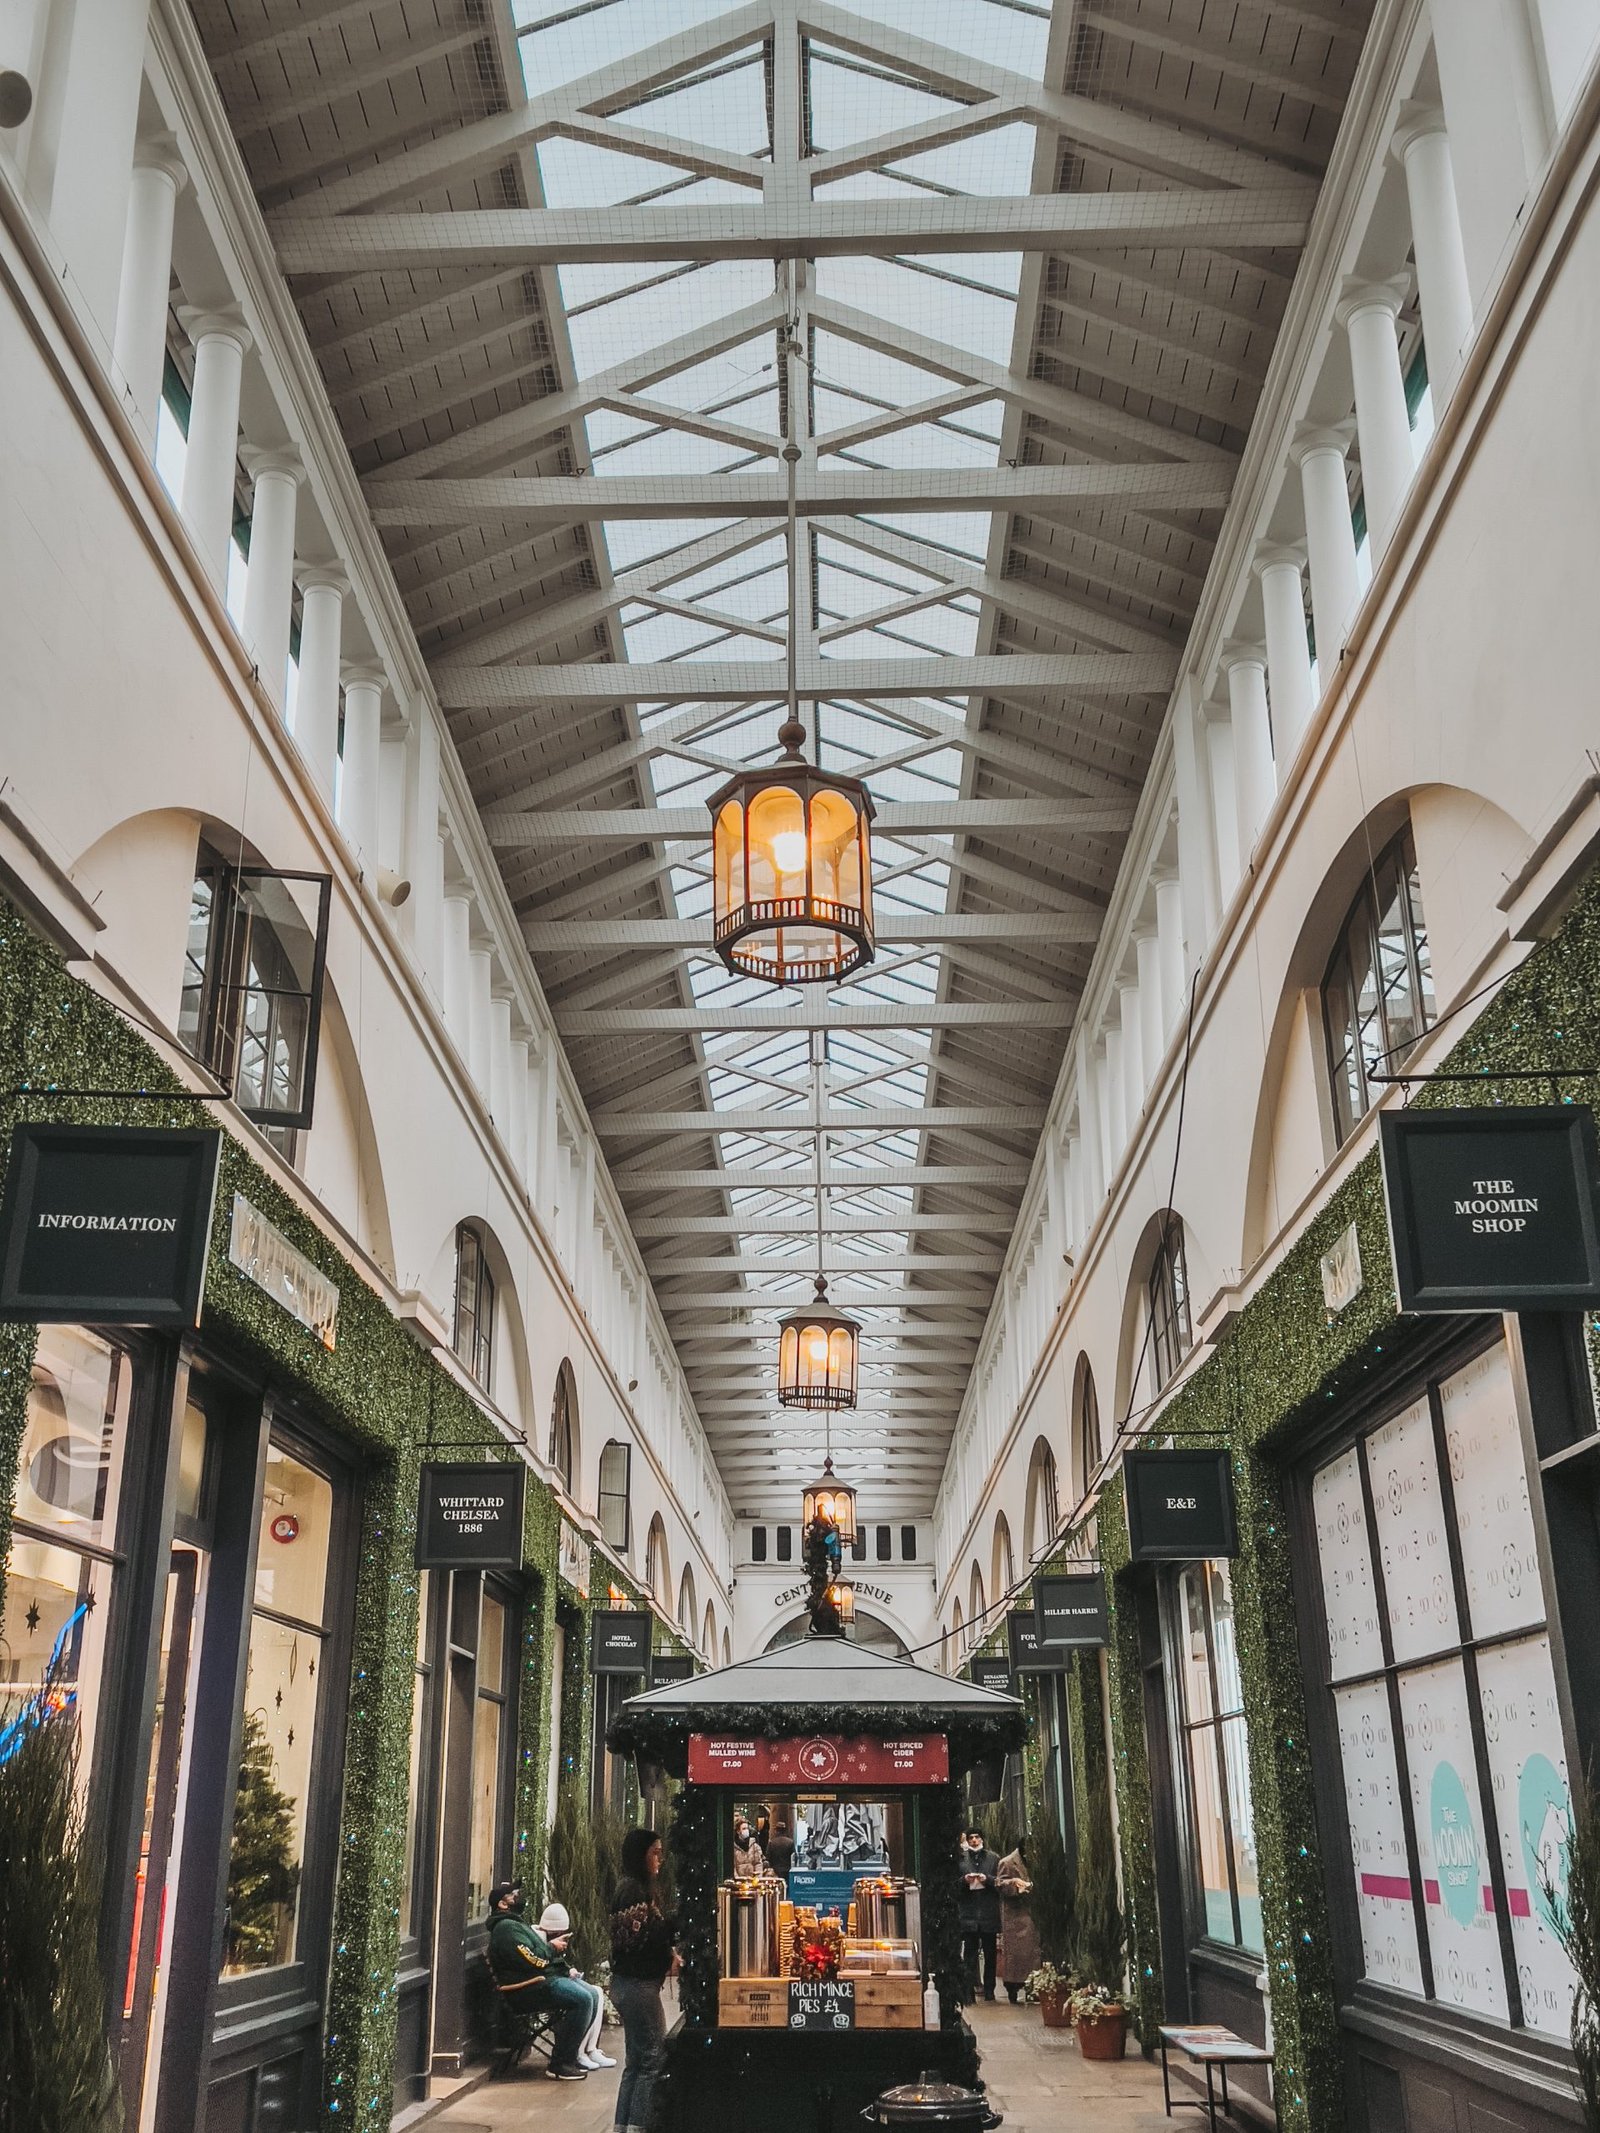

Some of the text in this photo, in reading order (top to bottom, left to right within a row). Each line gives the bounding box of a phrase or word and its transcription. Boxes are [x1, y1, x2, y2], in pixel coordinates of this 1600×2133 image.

[1473, 1180, 1515, 1195] THE
[1454, 1198, 1539, 1215] MOOMIN
[38, 1214, 177, 1232] INFORMATION
[1472, 1218, 1527, 1233] SHOP
[439, 1497, 505, 1507] WHITTARD
[1166, 1497, 1197, 1509] E&E
[443, 1510, 500, 1520] CHELSEA
[458, 1523, 483, 1533] 1886
[774, 1583, 809, 1607] CENT
[1044, 1607, 1099, 1616] MILLER HARRIS
[708, 1749, 756, 1757] MULLED WINE
[893, 1749, 914, 1757] CIDER
[722, 1760, 742, 1768] £7.00
[1441, 1806, 1458, 1824] THE
[1448, 1870, 1470, 1887] SHOP
[791, 1981, 854, 1998] RICH MINCE
[799, 1999, 840, 2013] PIES £4
